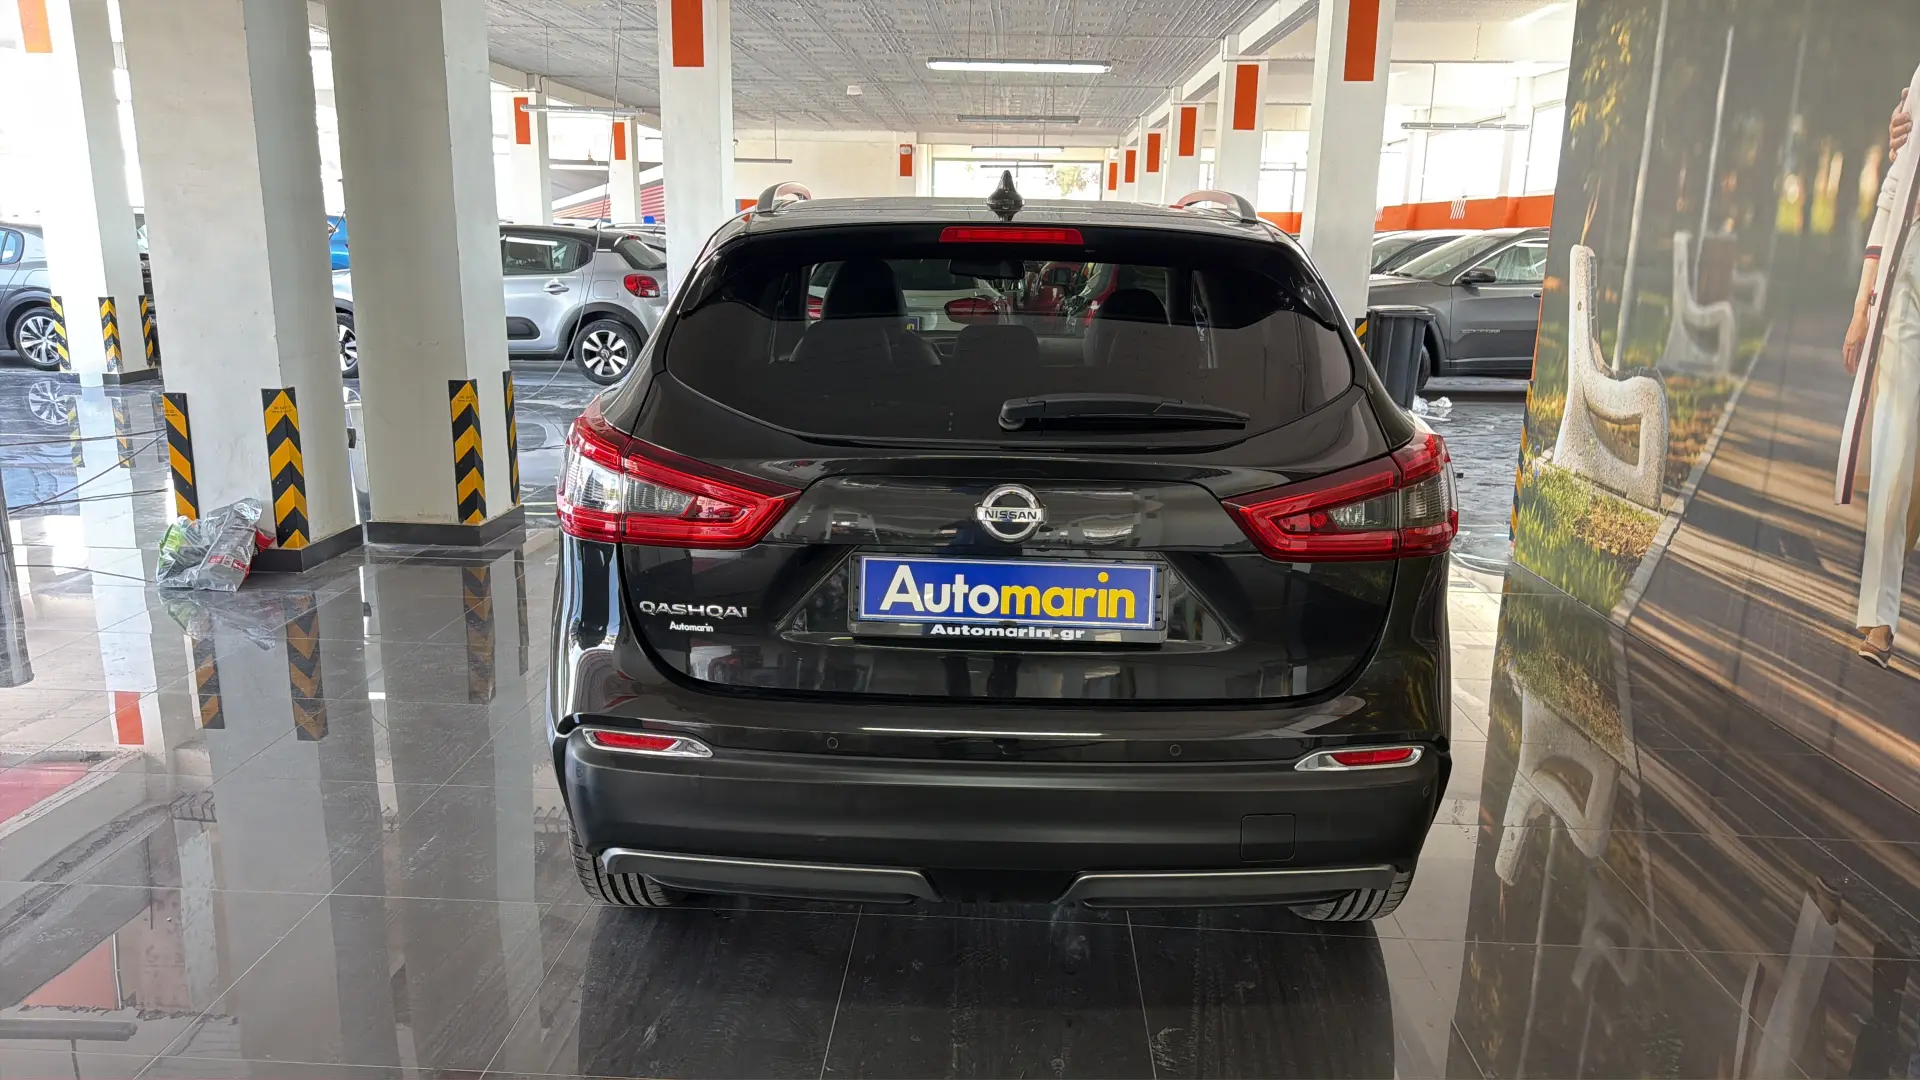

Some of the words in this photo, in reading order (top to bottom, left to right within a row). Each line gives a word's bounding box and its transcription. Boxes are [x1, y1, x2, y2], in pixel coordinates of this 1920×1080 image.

[984, 510, 1037, 520] NISSAN
[879, 564, 1136, 619] Automarin
[639, 600, 749, 620] QASHQAI
[669, 620, 714, 633] Automarin
[930, 623, 1086, 641] Automarin.gr
